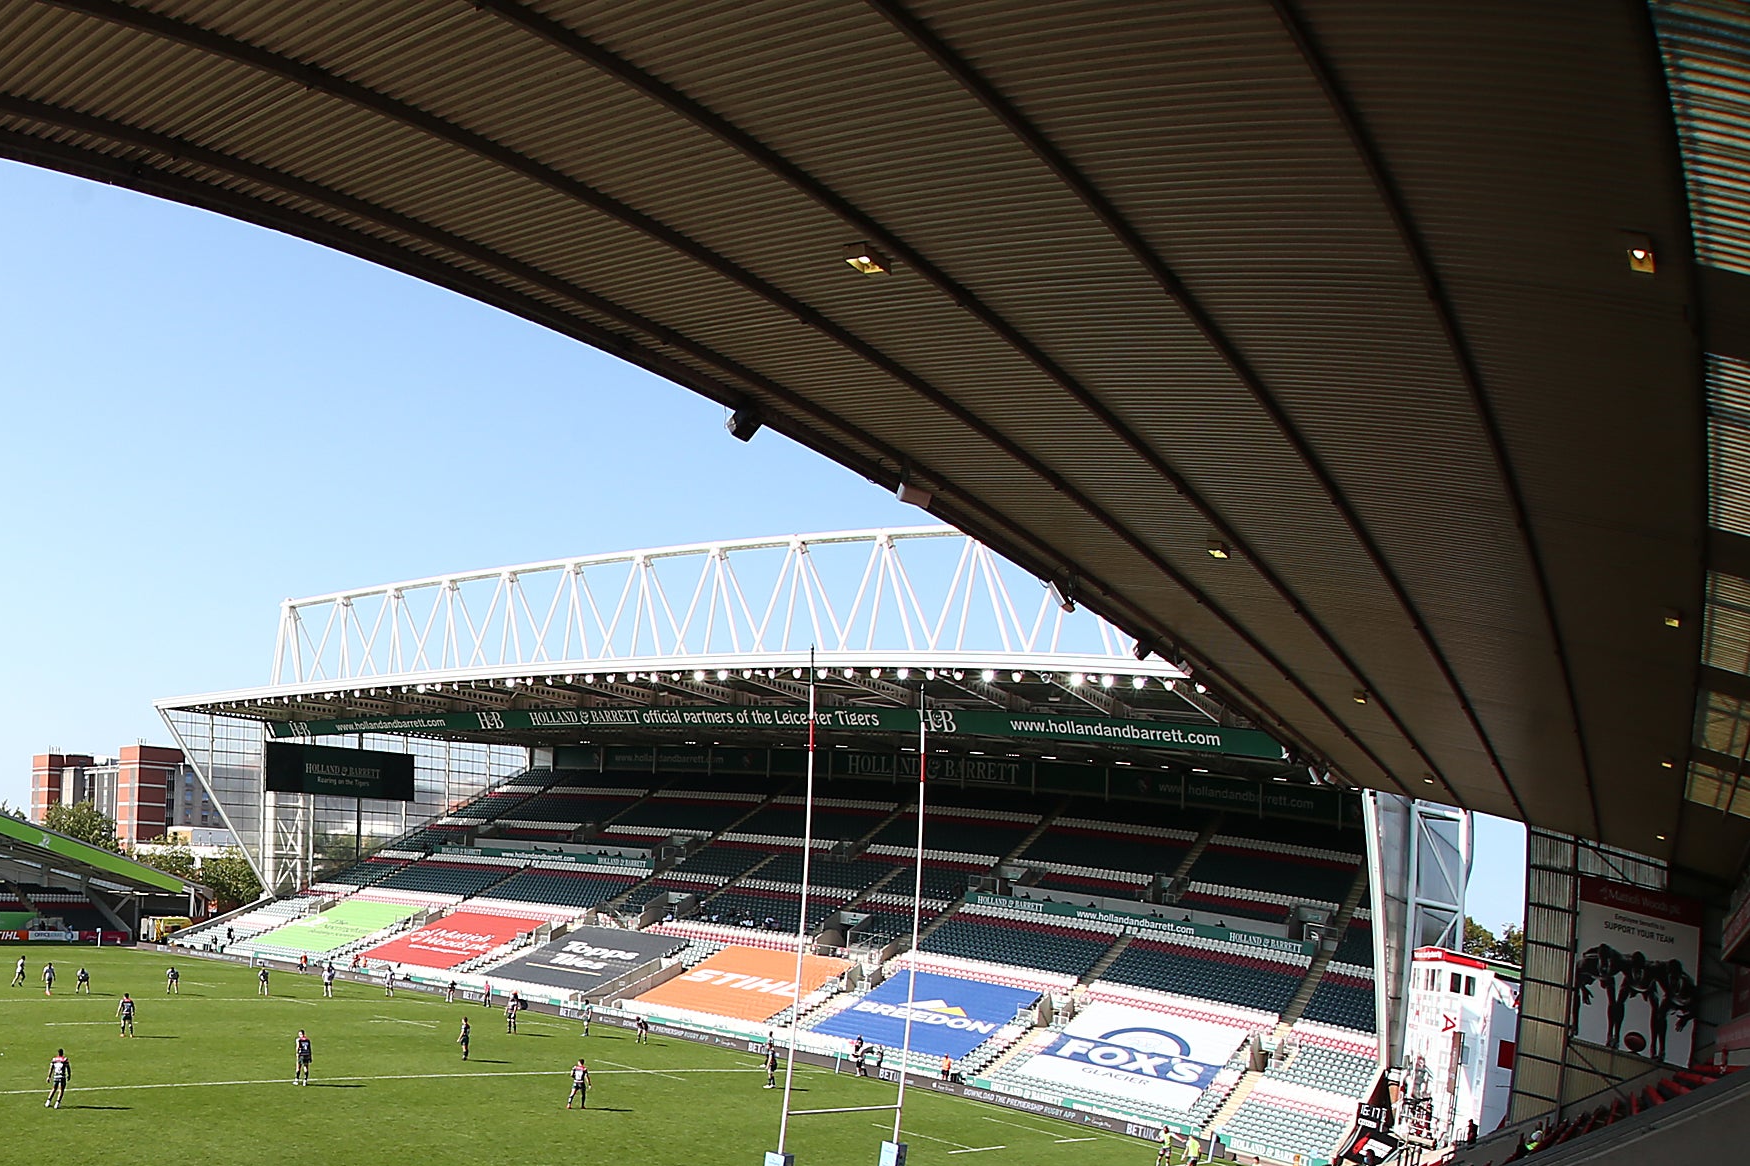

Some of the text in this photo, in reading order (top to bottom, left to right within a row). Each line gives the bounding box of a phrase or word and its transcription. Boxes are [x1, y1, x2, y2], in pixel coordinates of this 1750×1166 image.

[335, 717, 446, 732] www.hollandandbarrett.com
[529, 709, 880, 727] HOLLAND & BARRETT official partners of the Leiceter Tigers
[1010, 719, 1221, 746] www.hollandandbarrett.com
[305, 762, 340, 775] HOLLAND
[350, 767, 381, 779] BARRETT
[502, 851, 576, 862] www.hollandandbarrett.com
[977, 895, 1006, 908] HOLLAND
[1014, 900, 1044, 912] BARRETT
[1076, 910, 1194, 935] www.hollandandbarrett.com
[1604, 920, 1674, 944] SUPPORT YOUR TEAM
[562, 940, 640, 961] Topps
[1230, 932, 1262, 945] HOLLAND
[1270, 938, 1302, 954] BARRETT
[550, 952, 608, 970] Tiles
[682, 968, 799, 997] STIHL
[852, 1000, 997, 1034] BREEDON
[1056, 1038, 1204, 1083] FOX'S
[1082, 1066, 1150, 1086] GLACIER
[964, 1088, 1076, 1119] DOWNLOAD THE PREMIERSHIP RUGBY APP
[1230, 1138, 1266, 1156] HOLLAND
[1274, 1148, 1308, 1166] BARRTT
